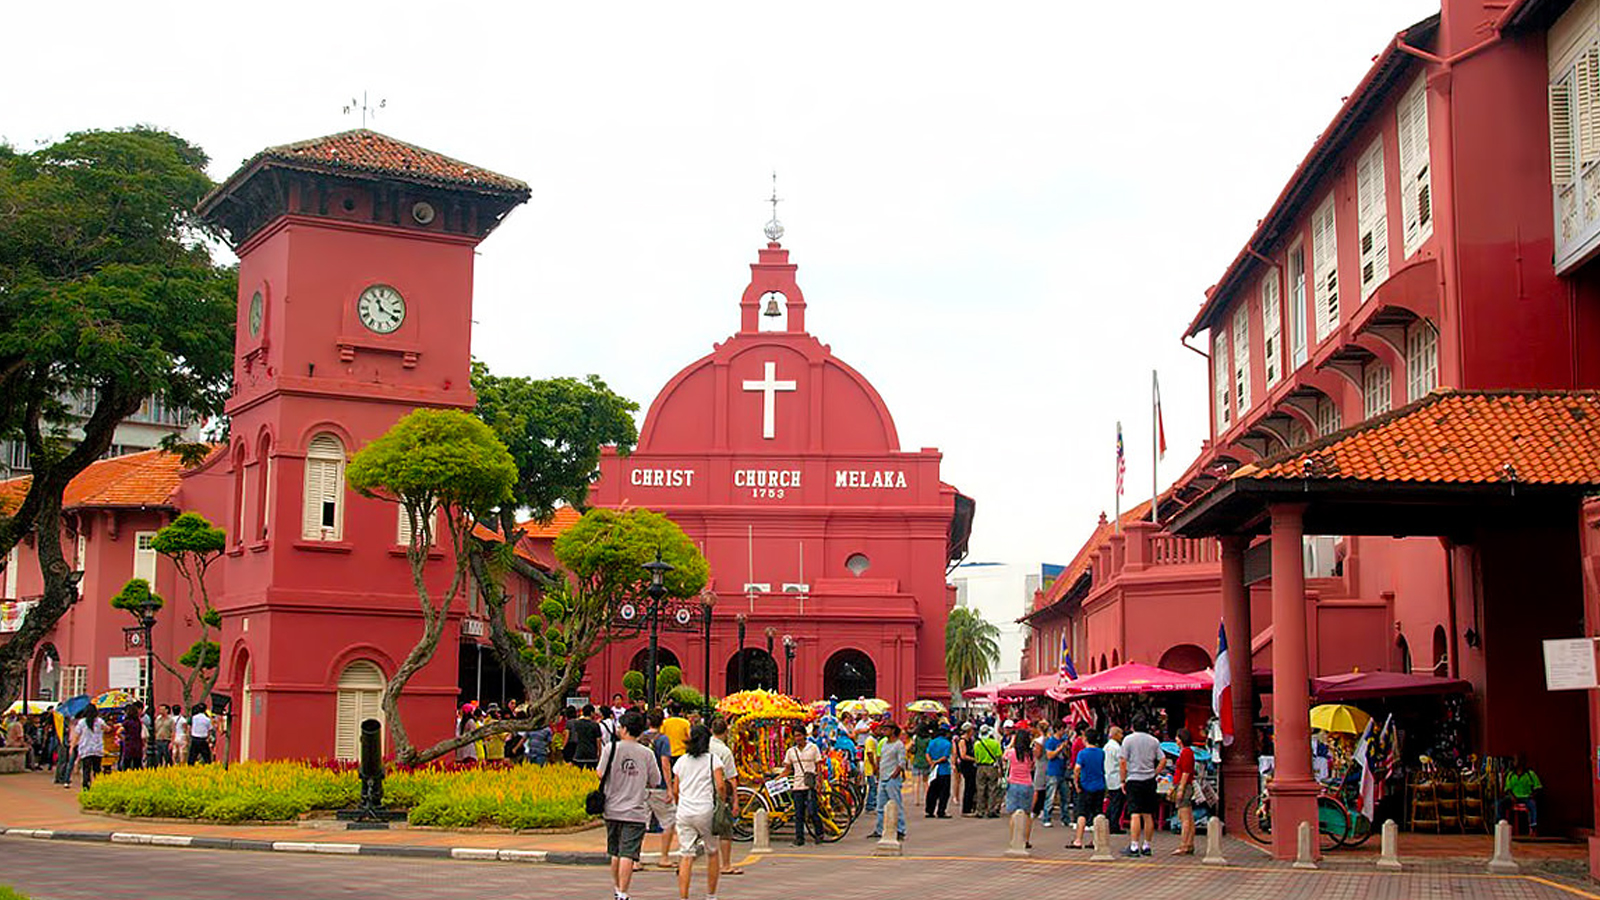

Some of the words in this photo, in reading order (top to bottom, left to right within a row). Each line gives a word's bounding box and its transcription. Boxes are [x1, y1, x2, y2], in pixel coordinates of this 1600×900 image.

[631, 469, 694, 487] CHRIST
[734, 470, 801, 487] CHURCH
[835, 470, 907, 488] MELAKA
[752, 488, 785, 499] 1753
